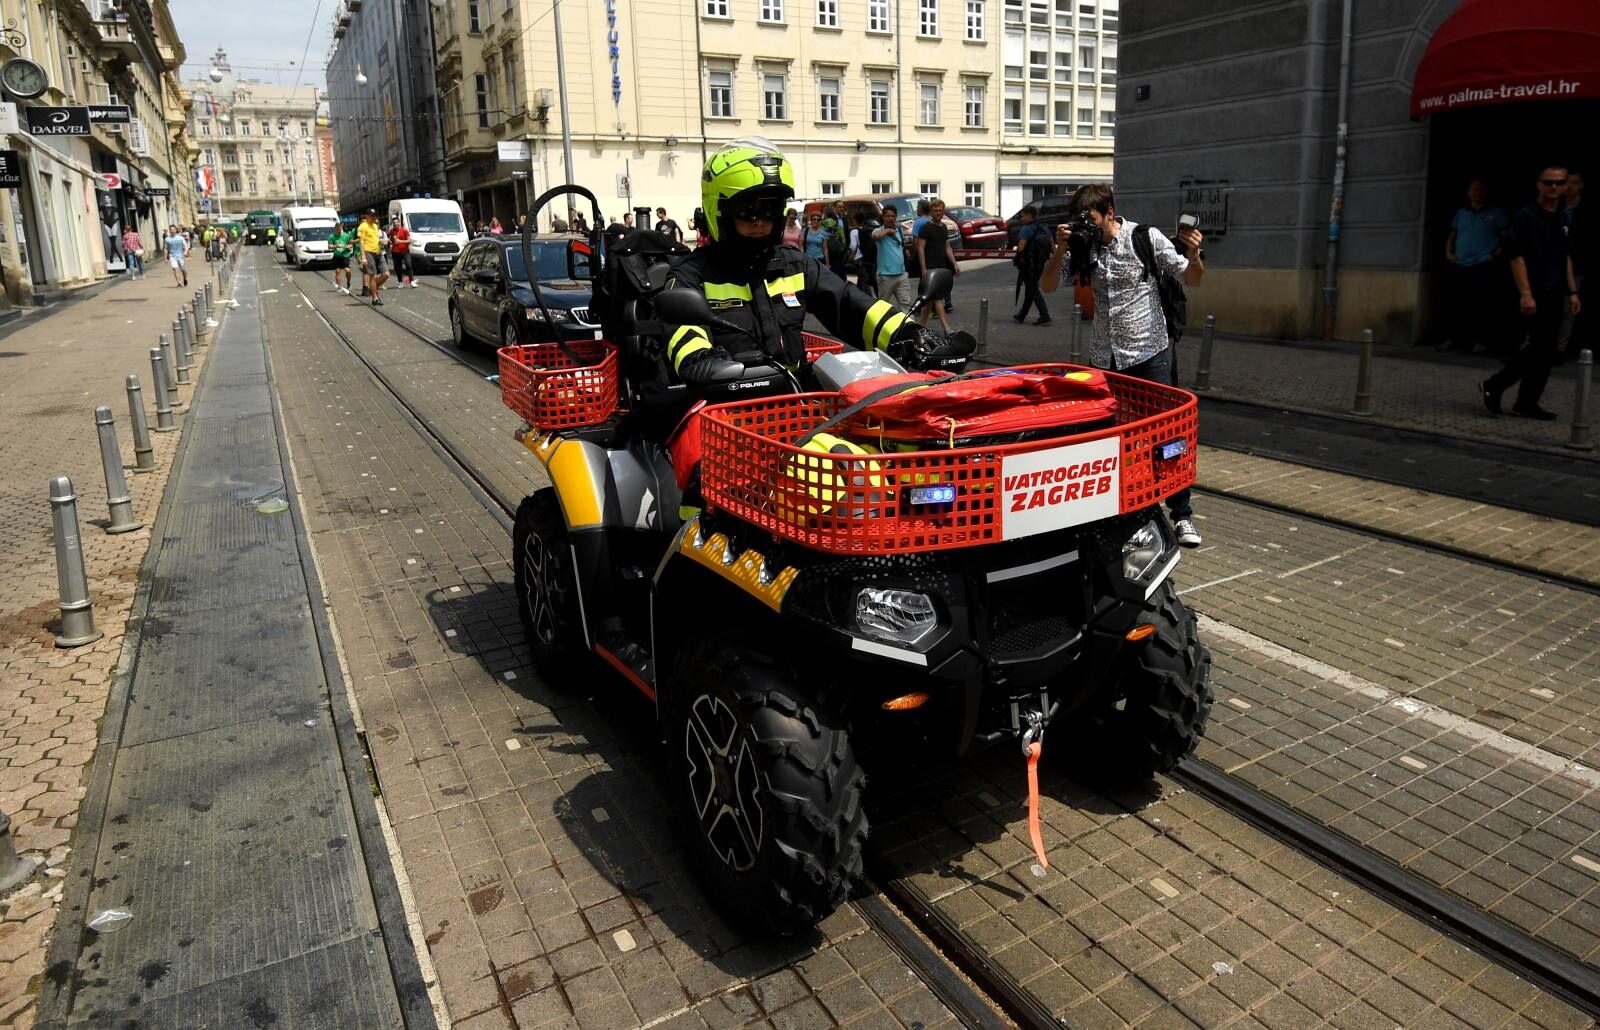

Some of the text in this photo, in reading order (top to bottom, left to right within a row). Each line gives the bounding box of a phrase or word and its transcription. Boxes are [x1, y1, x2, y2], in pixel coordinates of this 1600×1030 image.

[1449, 79, 1580, 107] palma-travel.hr
[32, 125, 88, 134] DARVEL
[739, 380, 770, 389] POLARIS
[1004, 456, 1118, 492] VATROGASCI
[1010, 475, 1112, 512] ZAGREB
